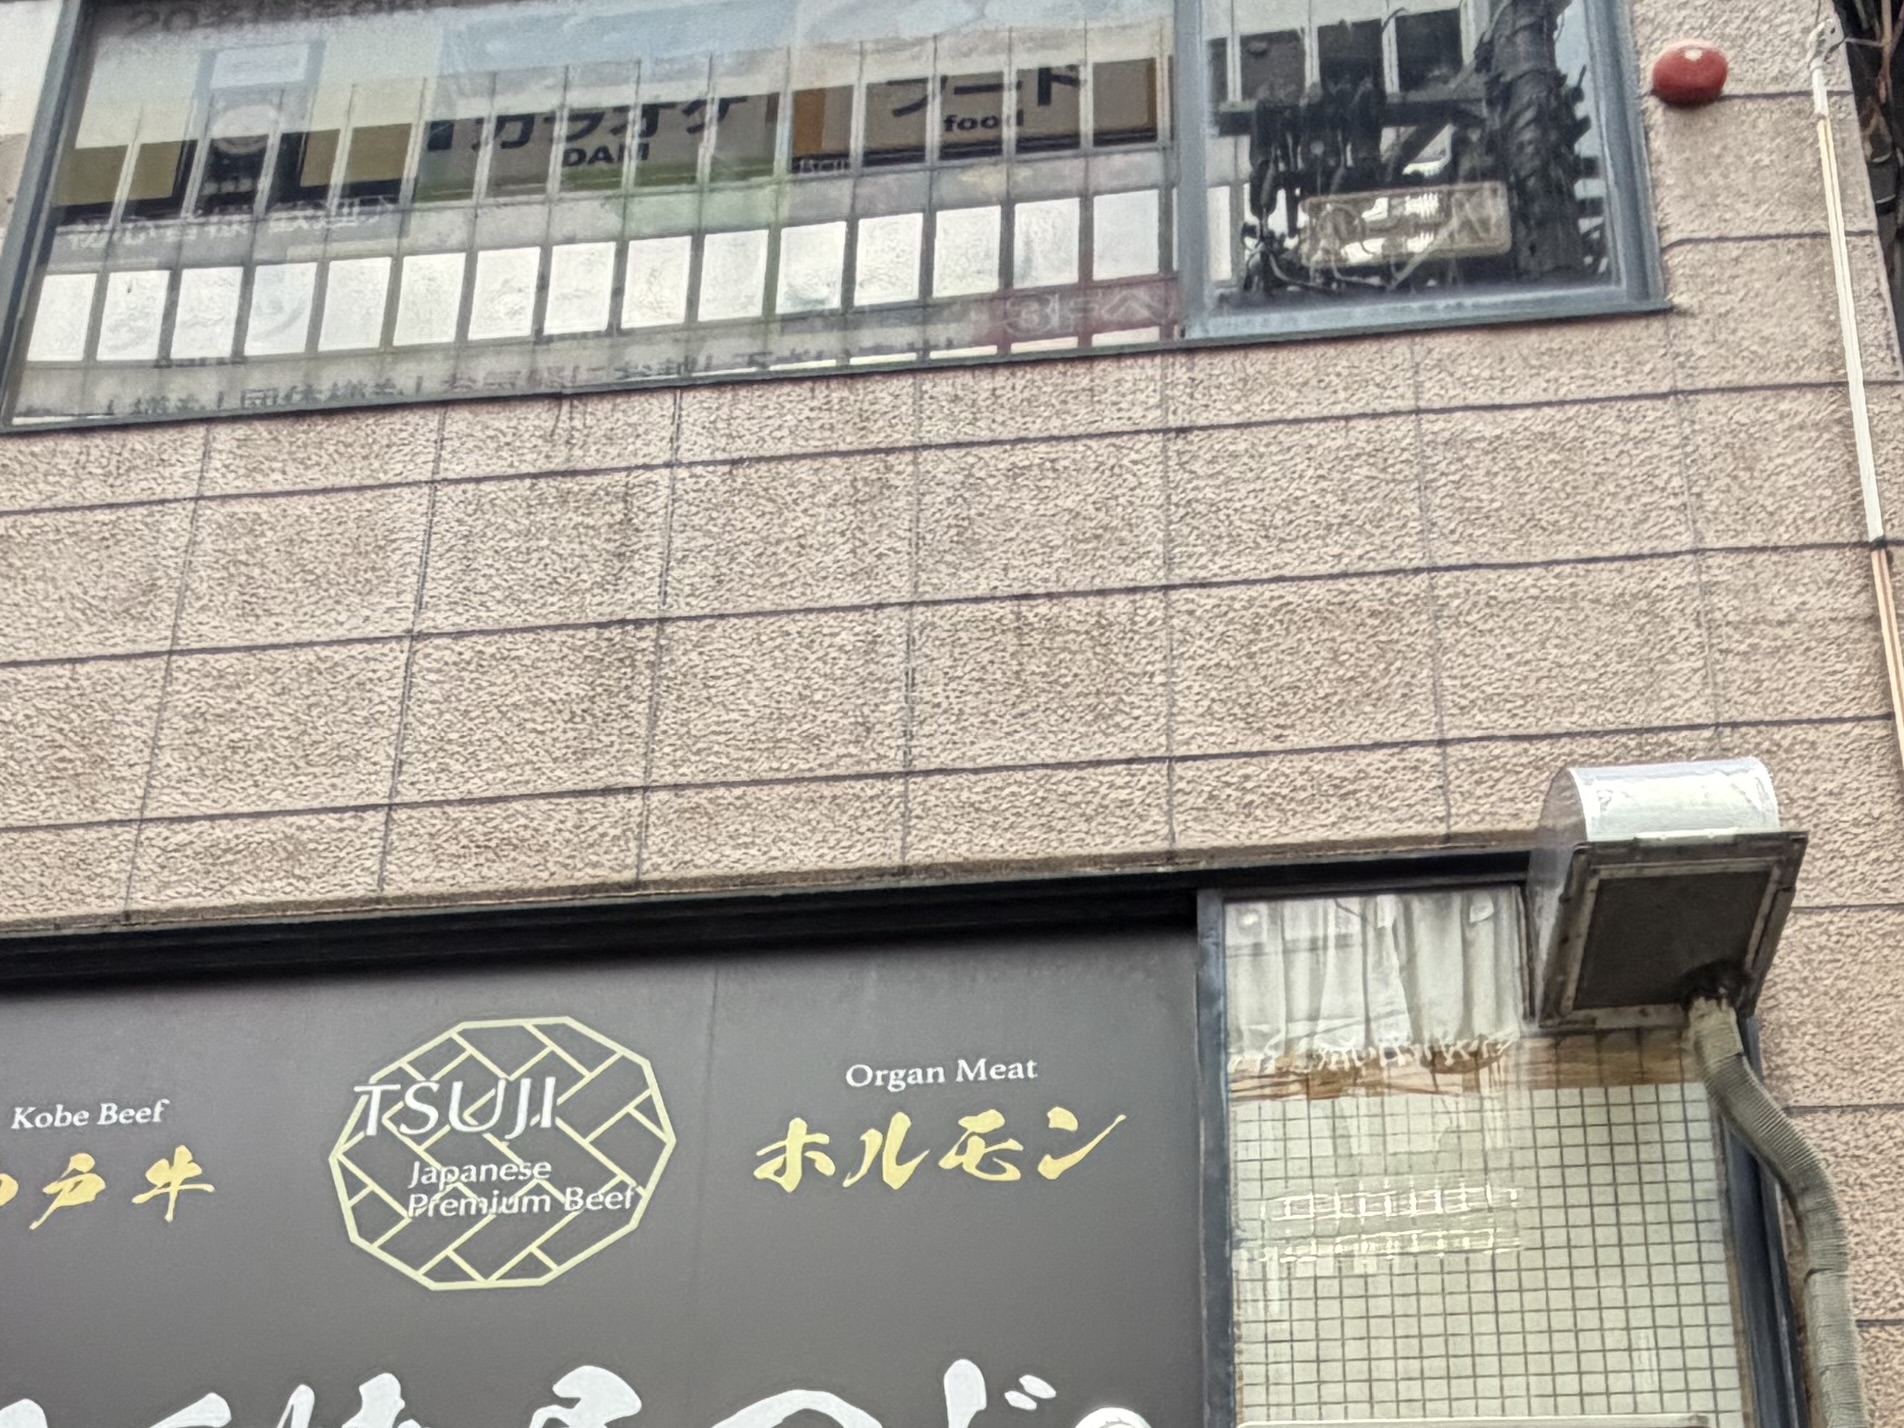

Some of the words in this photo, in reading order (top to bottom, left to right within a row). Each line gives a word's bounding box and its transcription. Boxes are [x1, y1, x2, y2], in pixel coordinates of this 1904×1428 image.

[844, 1060, 947, 1090] Organ
[954, 1056, 1039, 1083] Meat
[10, 1104, 90, 1131] Kobe
[96, 1097, 171, 1127] Beef
[352, 1076, 557, 1141] TSUJI
[752, 1104, 1128, 1192] ホルモン
[407, 1159, 553, 1190] Japanese
[406, 1190, 552, 1218] Premium
[563, 1184, 637, 1213] Beef
